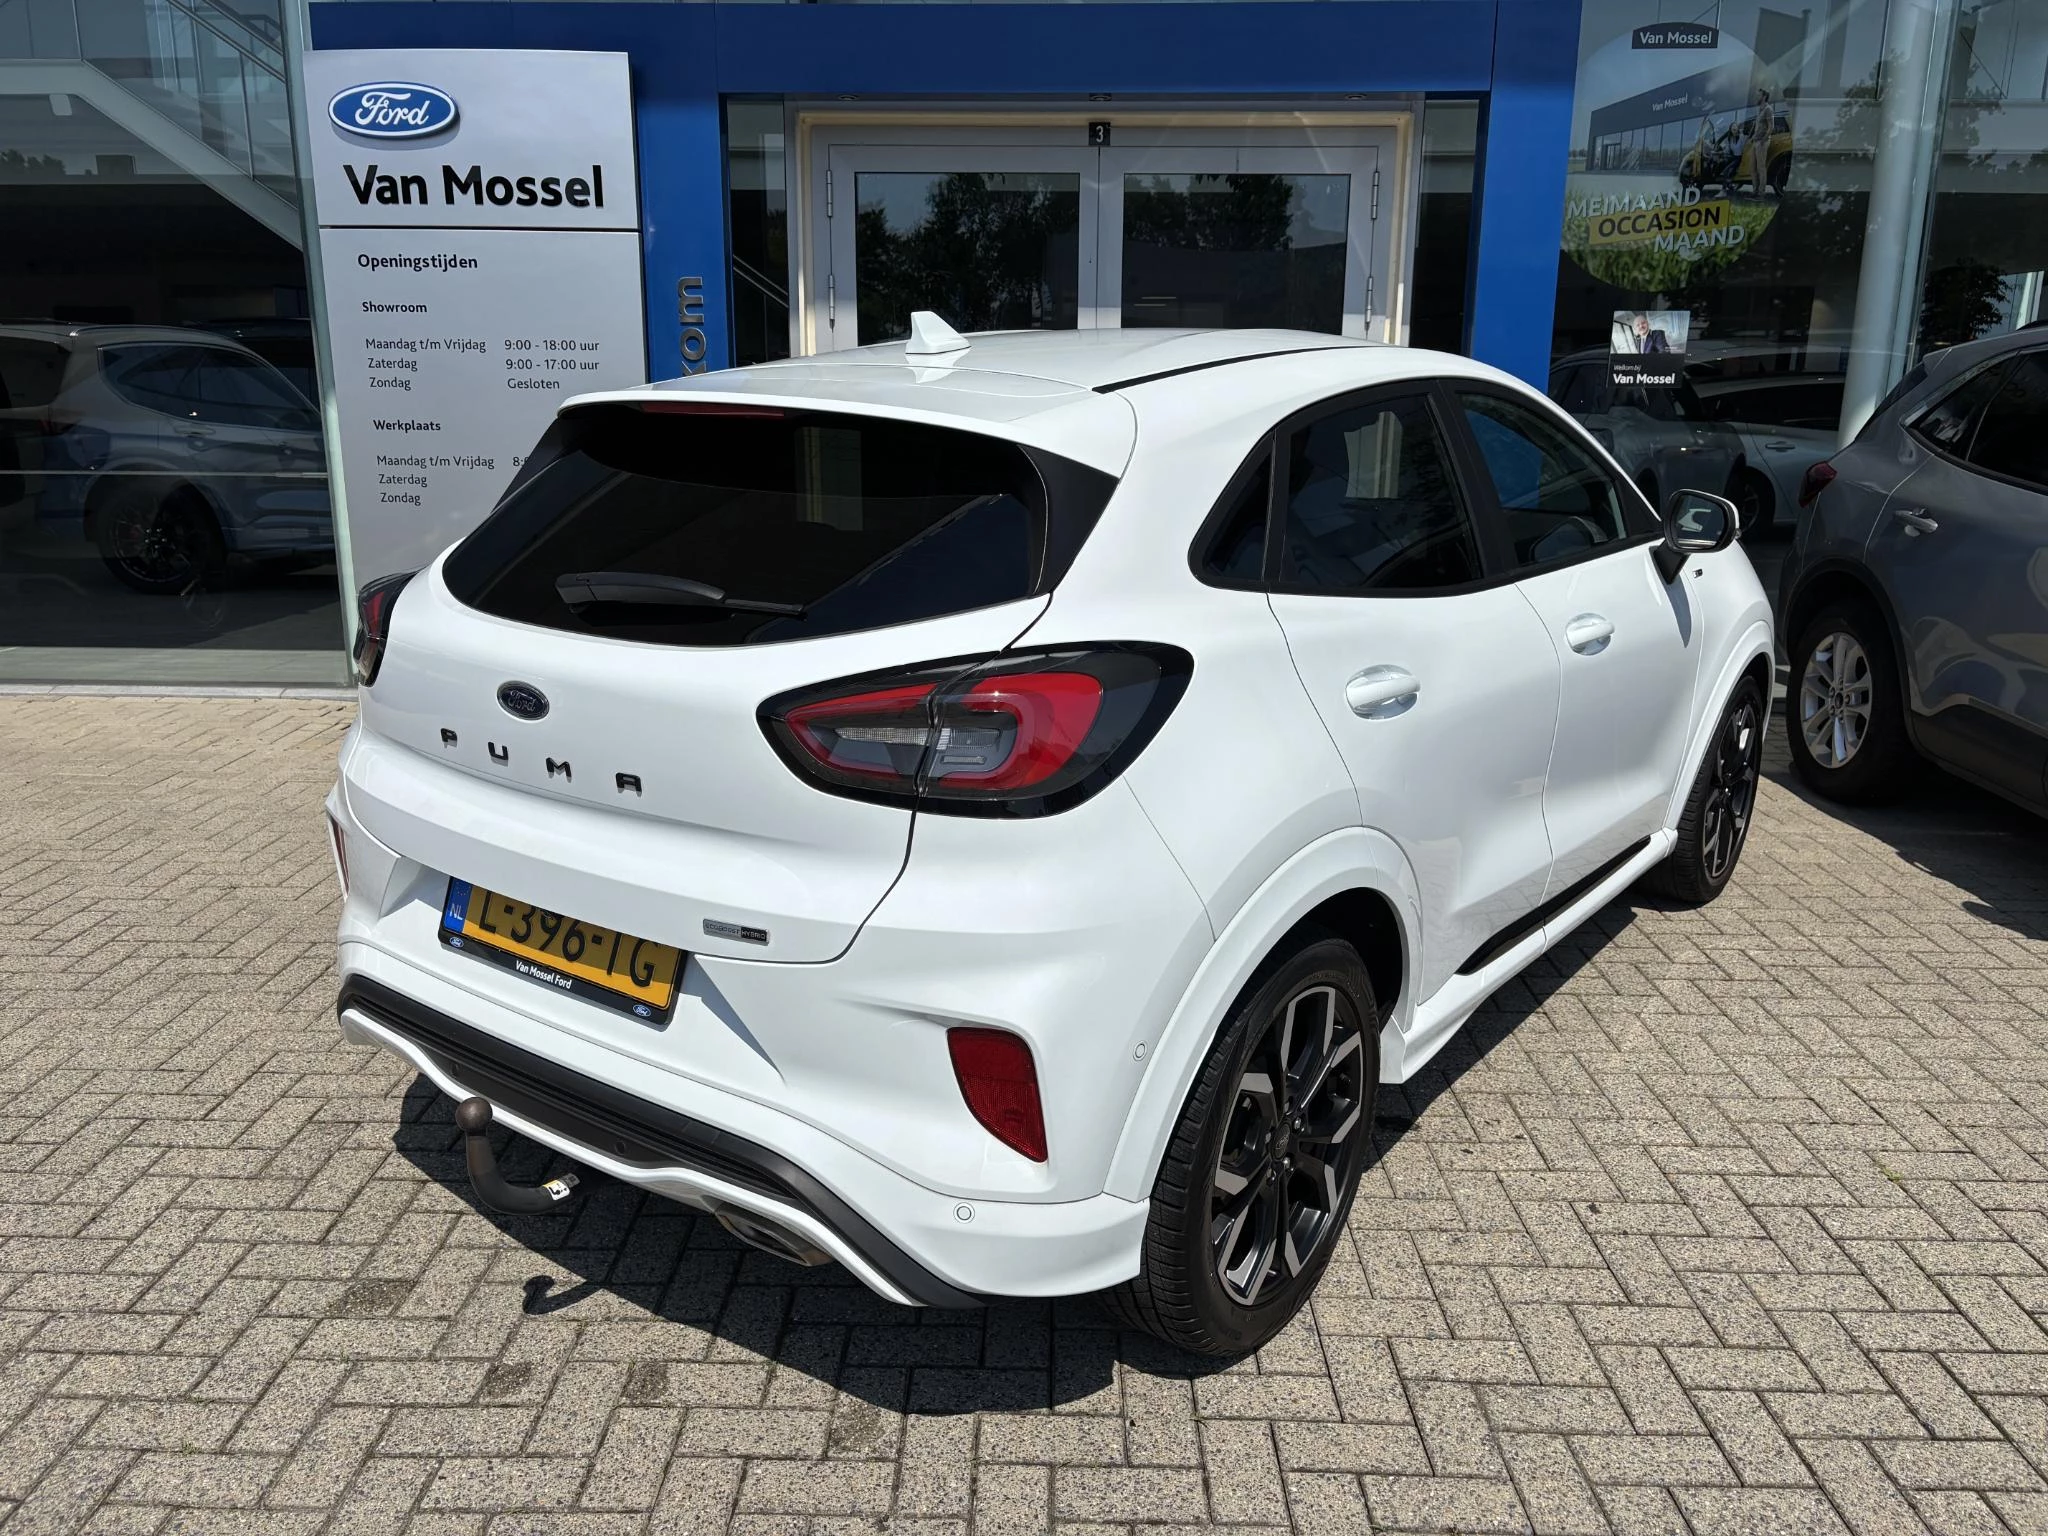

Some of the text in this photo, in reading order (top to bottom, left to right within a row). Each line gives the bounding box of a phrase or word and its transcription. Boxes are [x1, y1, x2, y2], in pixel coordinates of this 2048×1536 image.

[1640, 31, 1712, 44] Van Mossel
[354, 91, 431, 127] Ford
[1652, 93, 1688, 111] Van Mossel
[1096, 125, 1104, 143] 3
[343, 164, 604, 208] Van Mossel
[1567, 186, 1701, 219] MEIMAAND
[1598, 206, 1721, 238] OCCASION
[1654, 225, 1745, 253] MAAND
[357, 253, 478, 272] Openingstijden
[362, 301, 428, 314] Showroom
[365, 338, 417, 352] Maandag
[419, 338, 441, 351] t/m
[444, 339, 486, 353] Vrijdag
[504, 339, 531, 351] 9:00
[543, 339, 577, 351] 18:00
[580, 341, 600, 352] uur
[367, 357, 418, 372] Zaterdag
[505, 358, 532, 371] 9:00
[544, 358, 577, 371] 17:00
[580, 360, 600, 371] uur
[369, 376, 560, 391] Zondag Gesloten
[1613, 373, 1676, 384] Van Mossel
[373, 419, 442, 434] Werkplaats
[376, 455, 427, 469] Maandag
[429, 455, 451, 467] t/m
[454, 456, 495, 470] Vrijdag
[378, 474, 428, 488] Zaterdag
[380, 493, 421, 507] Zondag
[508, 690, 537, 712] Ford
[440, 728, 642, 798] PUMA
[449, 903, 463, 920] NL
[741, 931, 766, 939] HYBRID
[515, 960, 572, 989] Van Mossel Ford
